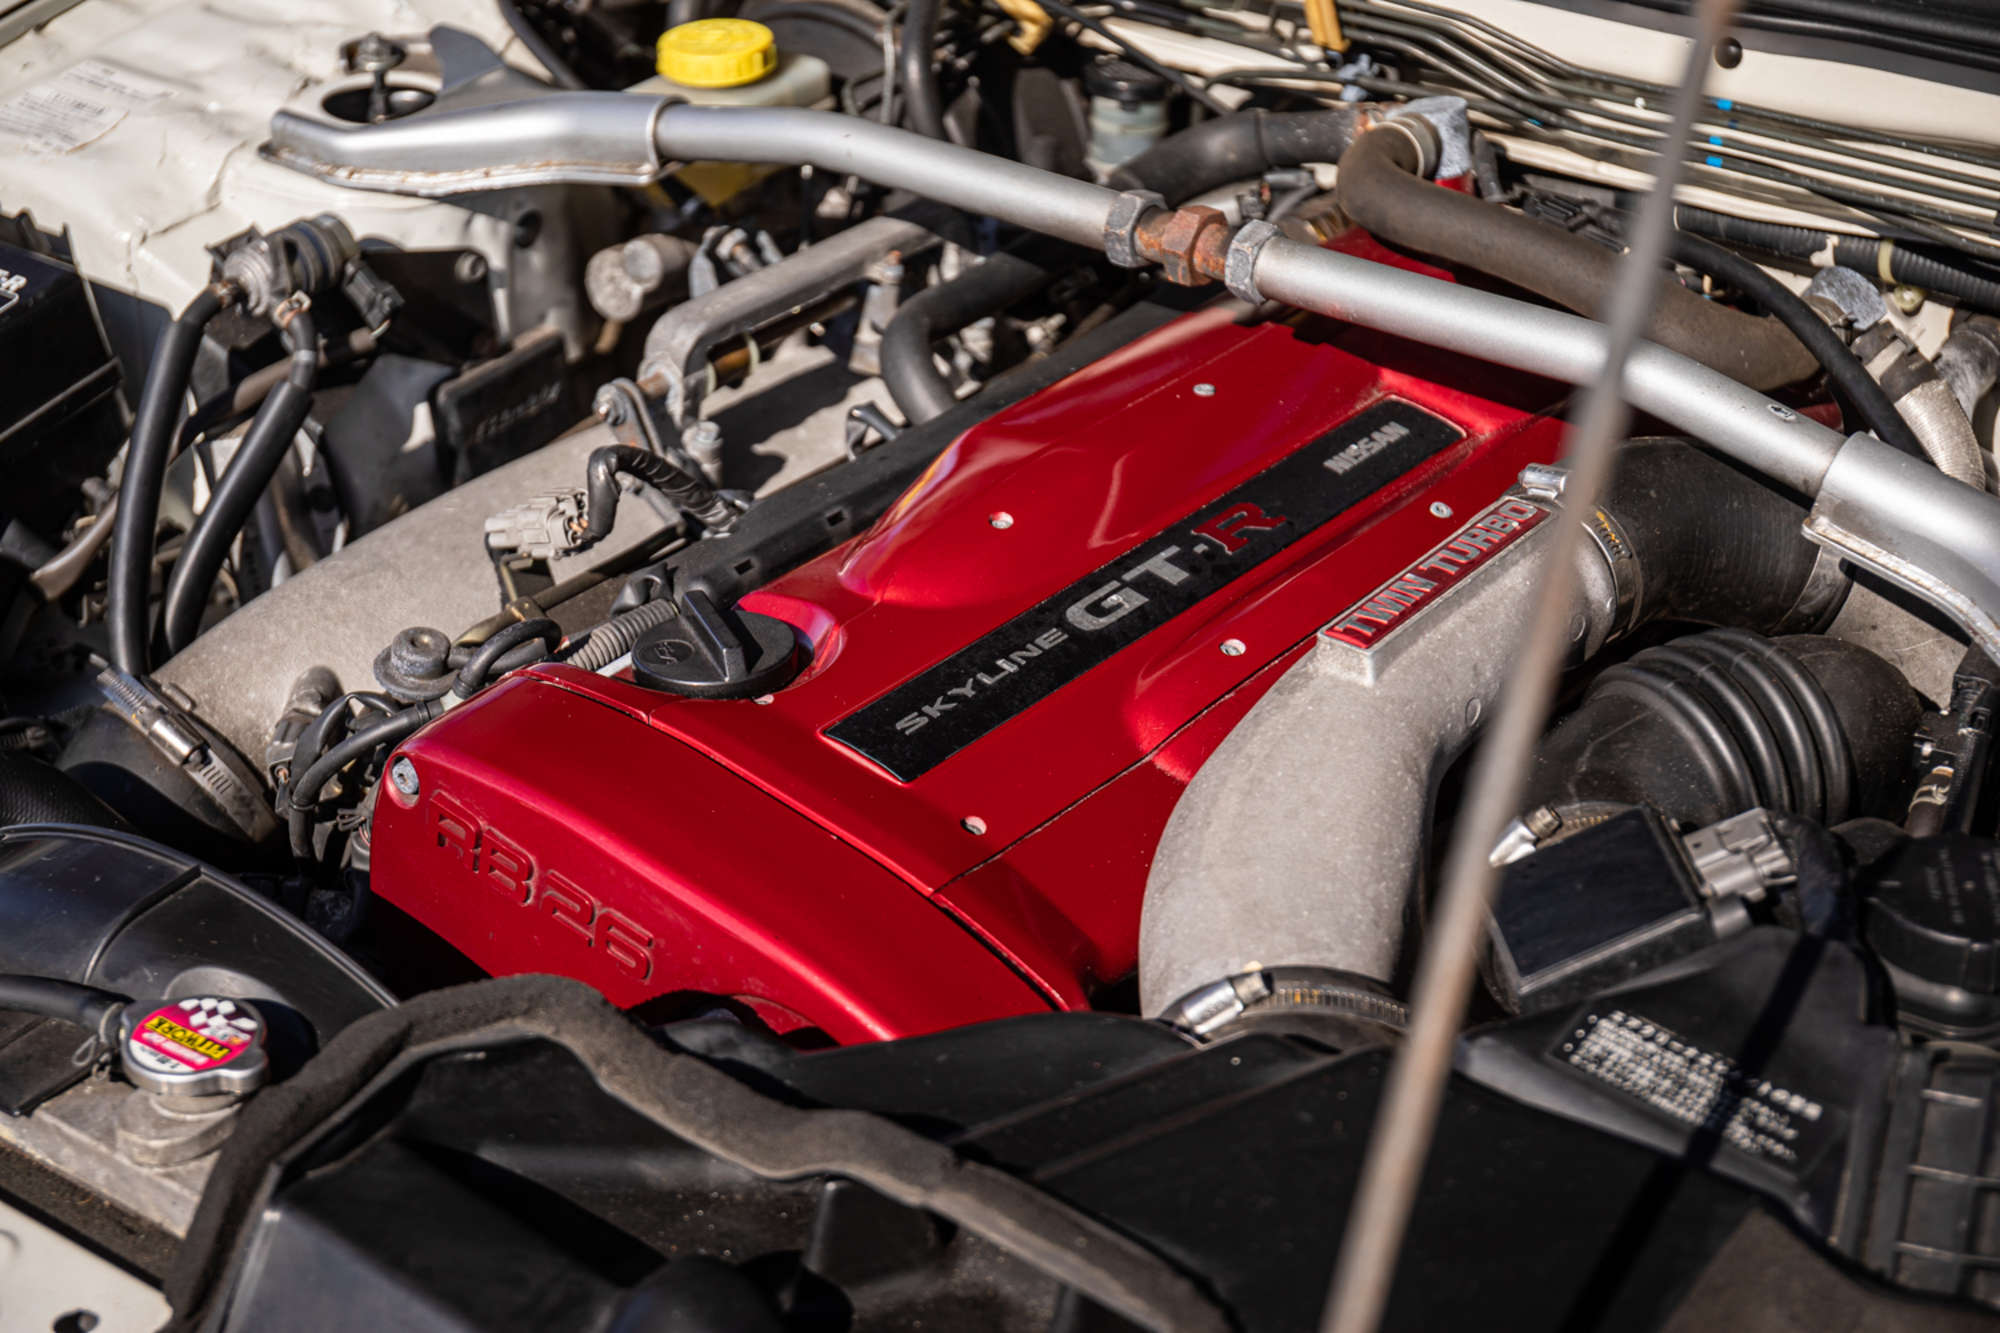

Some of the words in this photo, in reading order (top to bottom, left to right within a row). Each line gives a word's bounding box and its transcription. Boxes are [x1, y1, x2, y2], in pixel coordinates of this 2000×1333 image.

[1322, 421, 1410, 475] NISSAN
[1332, 573, 1439, 637] TWIN
[1418, 501, 1539, 576] TURBO
[896, 628, 1068, 736] SKYLINE
[430, 788, 654, 985] RB26
